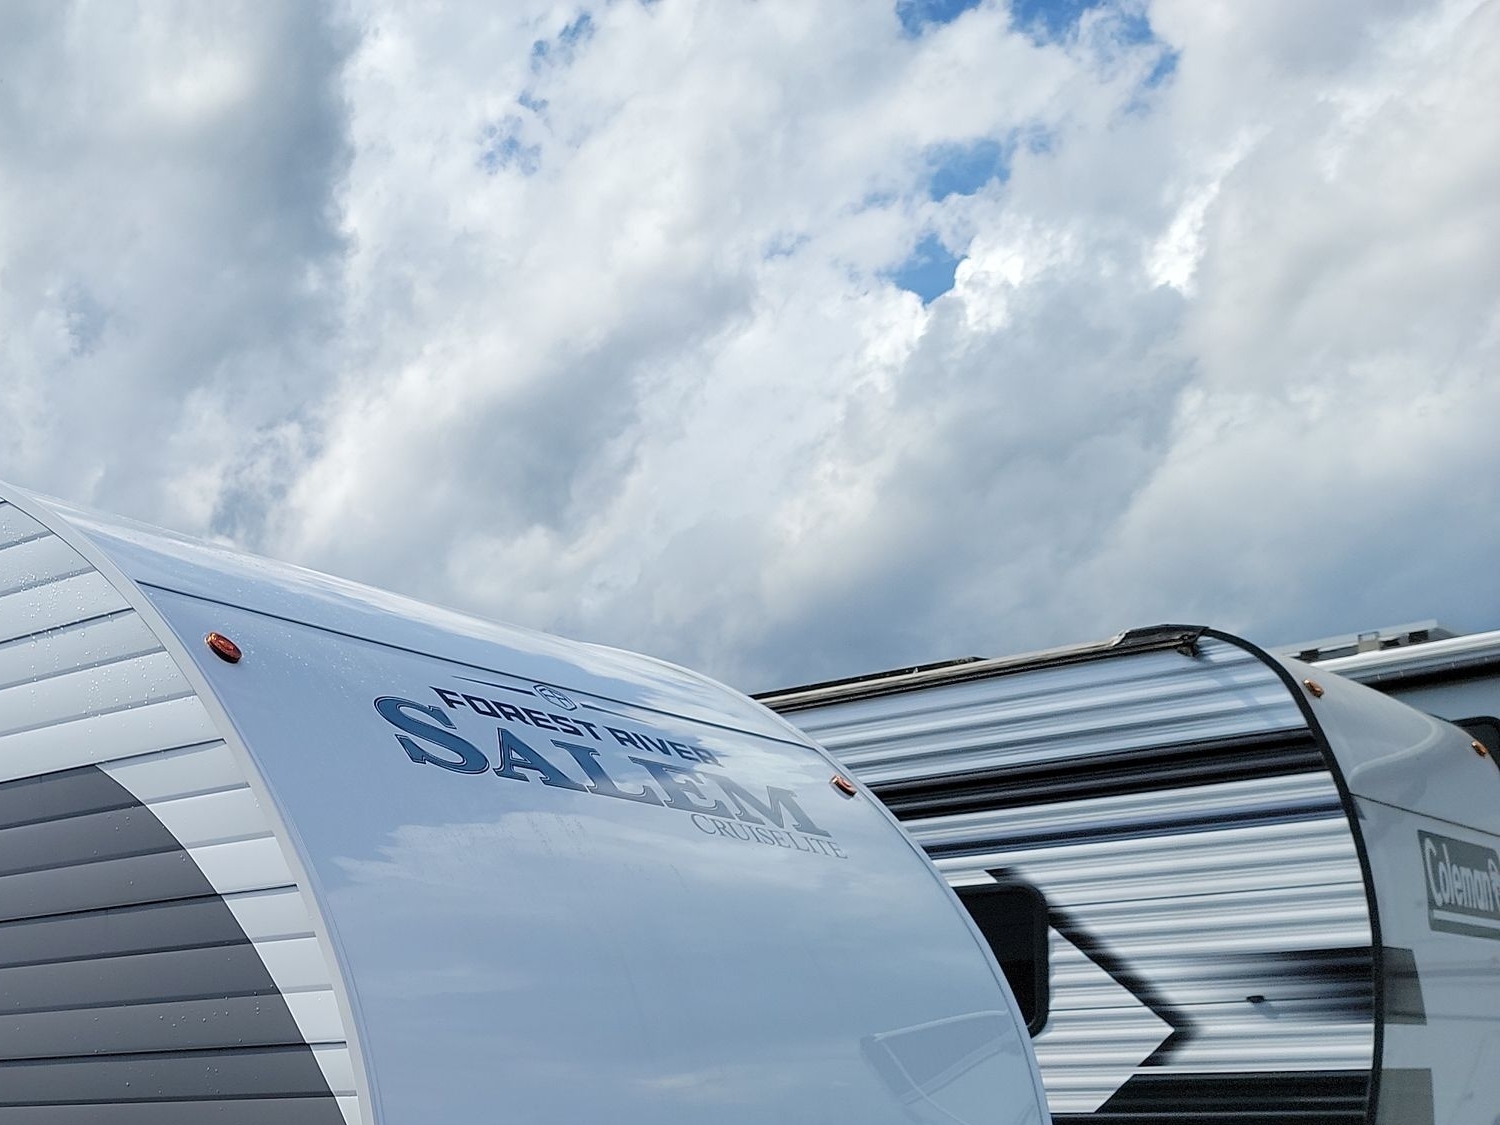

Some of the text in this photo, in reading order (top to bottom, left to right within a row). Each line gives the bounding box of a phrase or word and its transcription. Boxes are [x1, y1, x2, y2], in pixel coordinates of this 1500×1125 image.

[373, 696, 832, 838] SALEM
[429, 686, 725, 768] FOREST RIVER
[1424, 837, 1494, 912] Coleman
